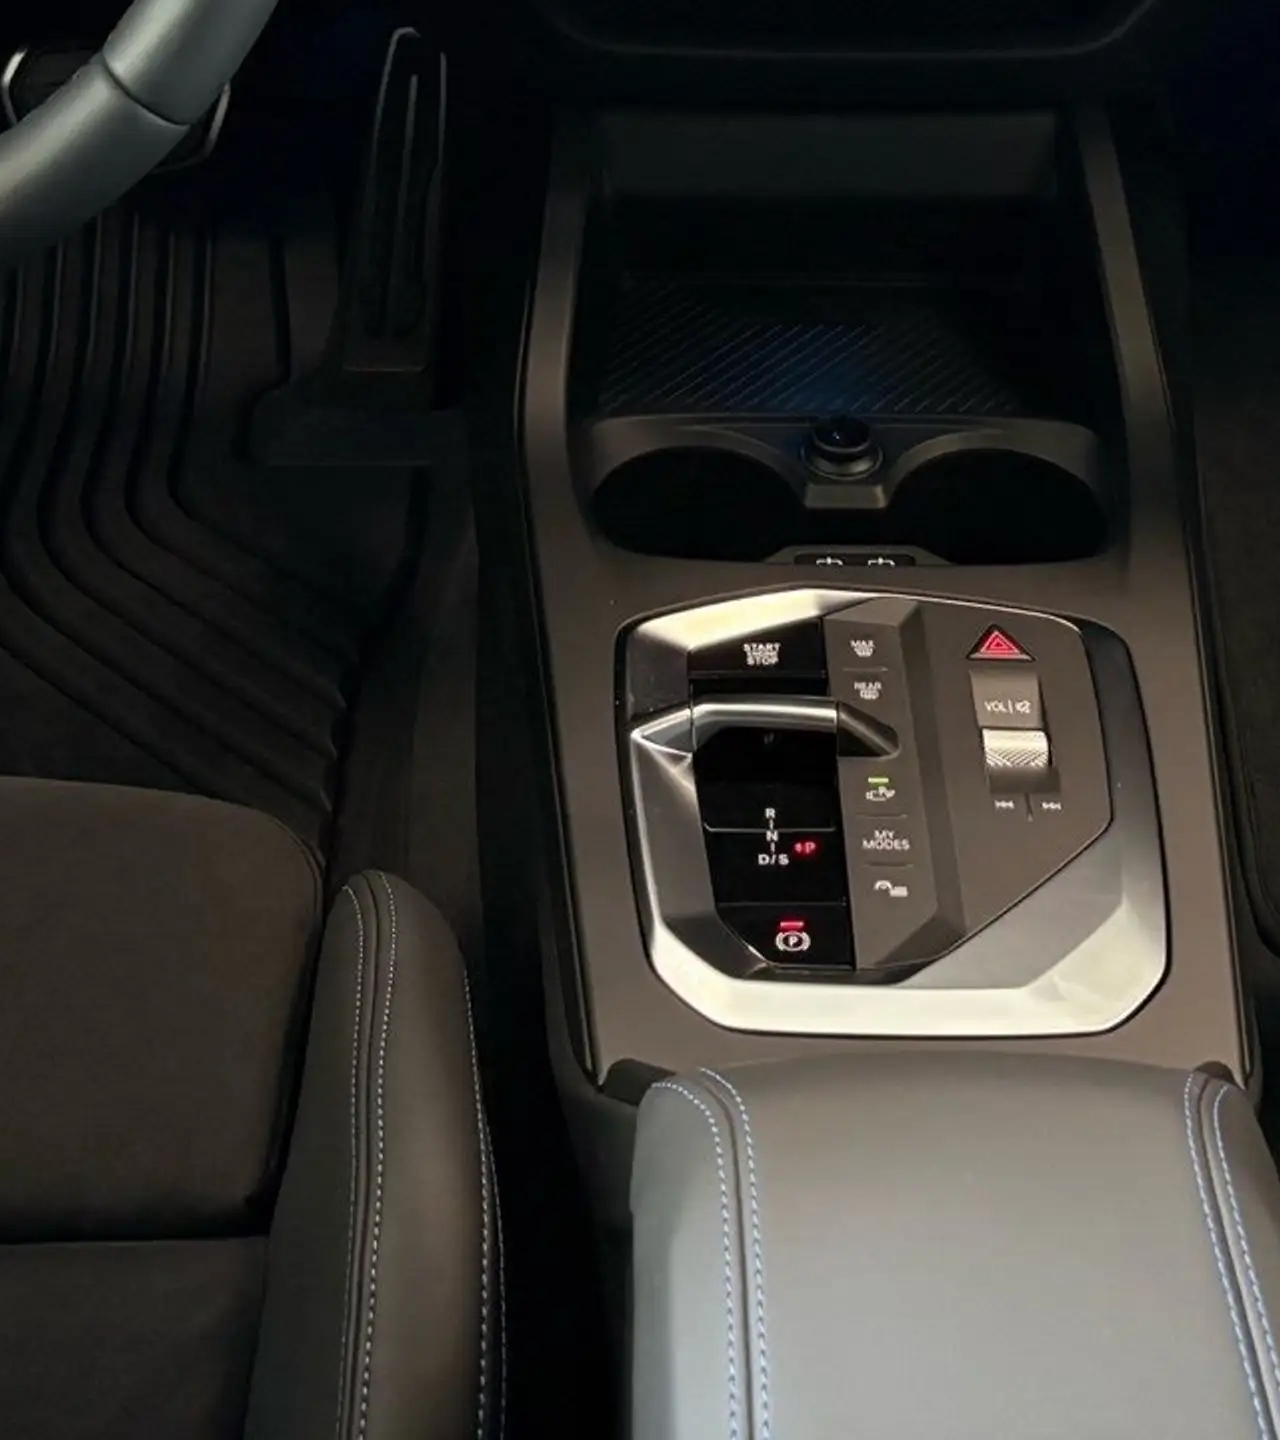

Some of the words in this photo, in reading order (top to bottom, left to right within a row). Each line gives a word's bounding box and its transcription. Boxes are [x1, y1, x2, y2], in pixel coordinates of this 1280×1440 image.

[984, 700, 1007, 712] VOL
[765, 808, 776, 819] R
[766, 830, 778, 842] N
[874, 829, 896, 840] MY
[862, 838, 910, 850] MODES
